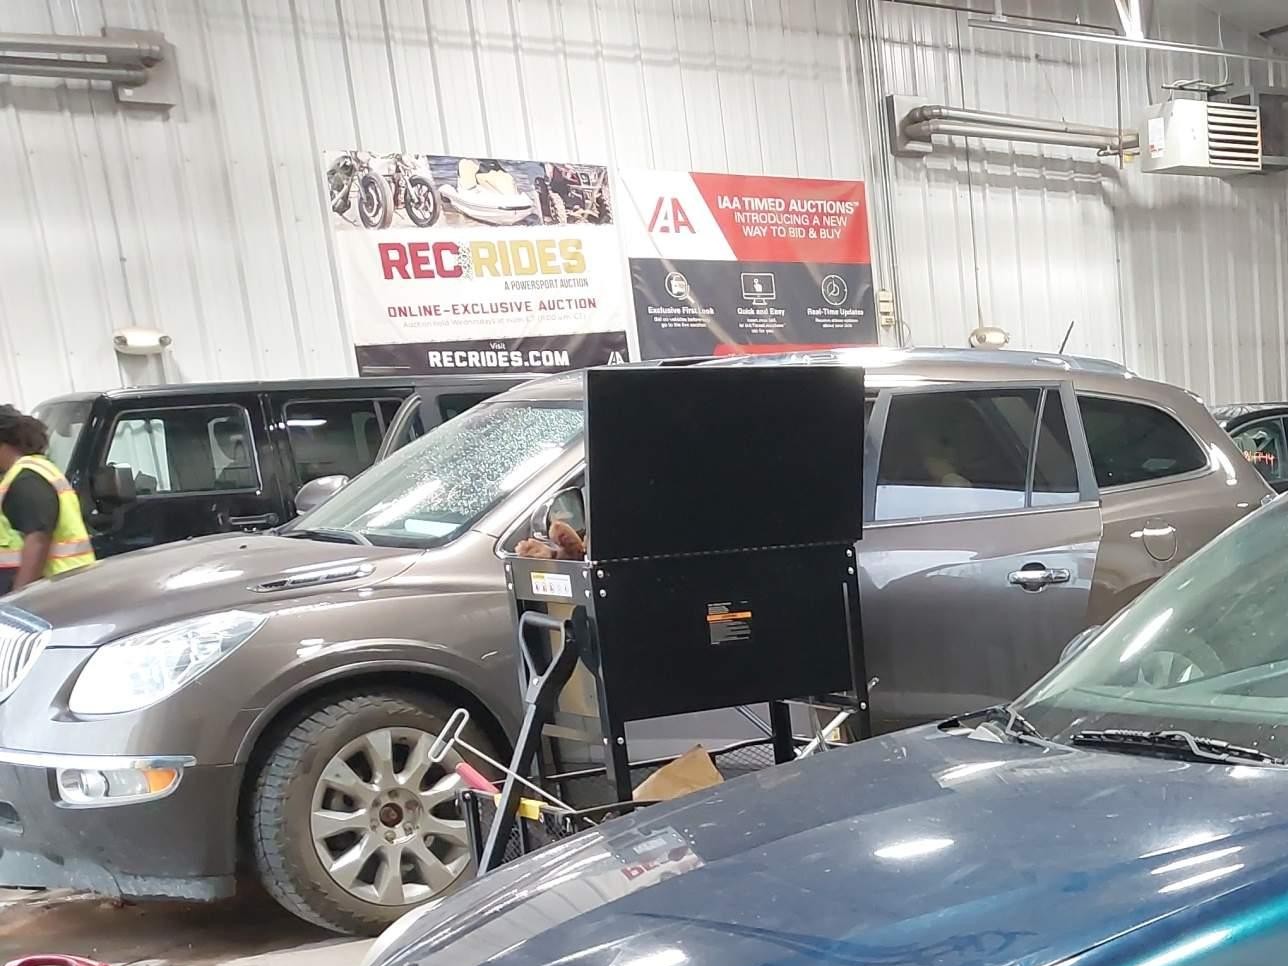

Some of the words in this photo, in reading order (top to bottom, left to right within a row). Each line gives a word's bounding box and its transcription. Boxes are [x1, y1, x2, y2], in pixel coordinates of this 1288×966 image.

[717, 195, 742, 210] IAA
[742, 196, 786, 212] TIMED
[734, 211, 810, 226] INTRODUCING
[812, 214, 821, 227] A
[822, 215, 848, 227] NEW
[742, 225, 768, 238] WAY
[770, 225, 787, 238] TO
[788, 226, 806, 238] BID
[808, 227, 818, 239] &
[819, 228, 842, 239] BUY
[378, 241, 464, 280] REC
[469, 239, 587, 278] RIDES
[504, 281, 511, 291] A
[511, 279, 559, 290] POWERSPORT
[560, 278, 590, 289] AUCTION
[387, 300, 533, 318] ONLINE-EXCLUSIVE
[538, 297, 598, 312] AUCTION
[647, 306, 681, 315] Exclusive
[737, 307, 755, 315] Quick
[756, 307, 769, 315] and
[769, 307, 785, 317] Easy
[807, 307, 839, 316] Real-Time
[840, 308, 865, 317] Updates
[489, 342, 507, 350] Visit
[428, 350, 571, 368] RECRIDES.COM
